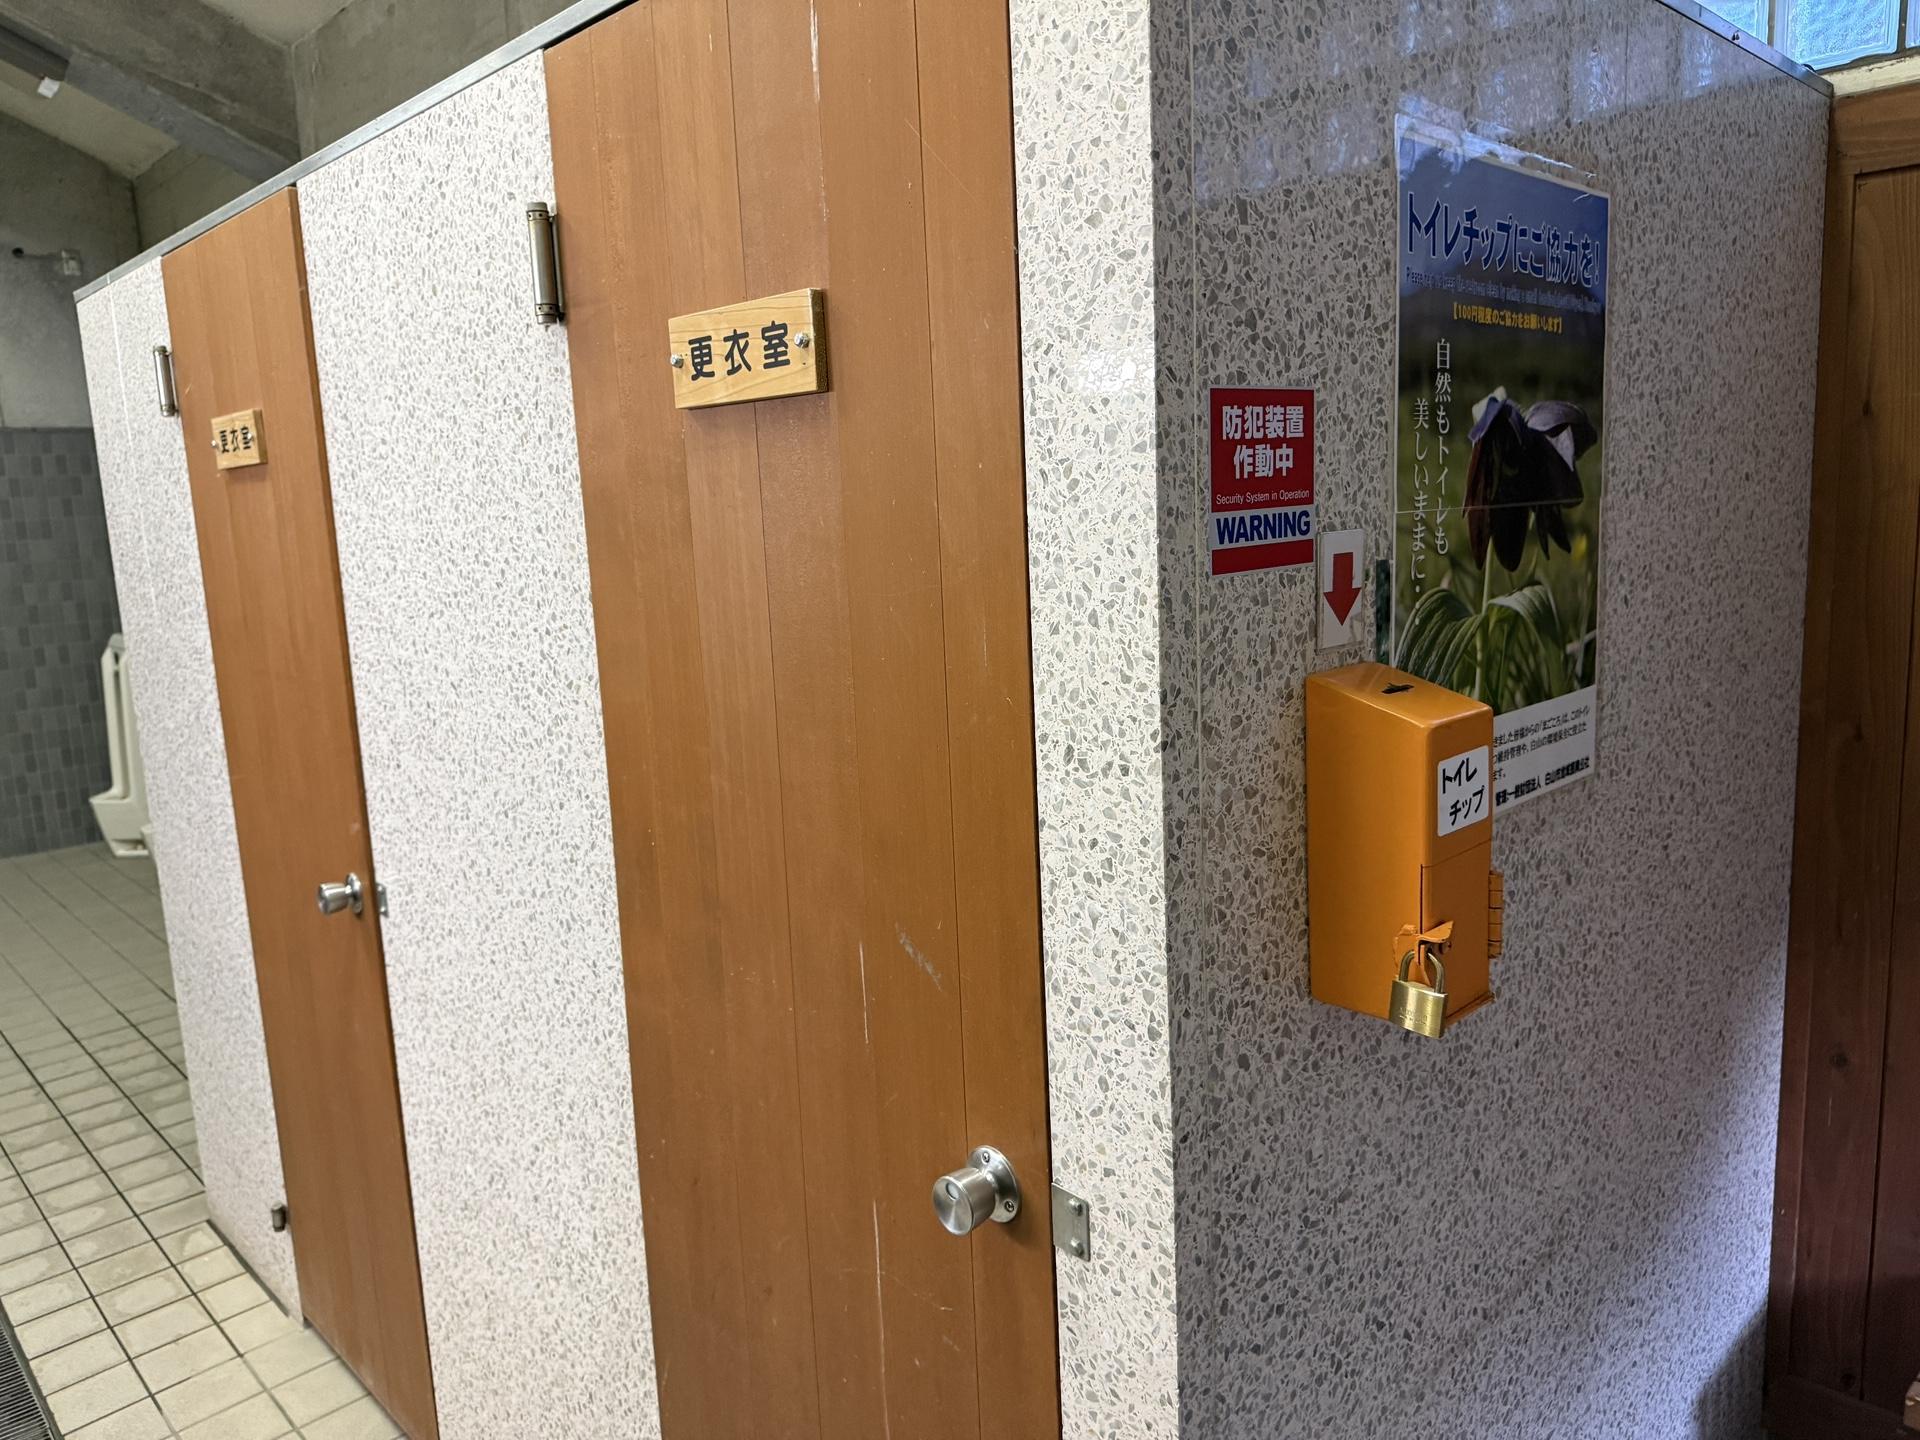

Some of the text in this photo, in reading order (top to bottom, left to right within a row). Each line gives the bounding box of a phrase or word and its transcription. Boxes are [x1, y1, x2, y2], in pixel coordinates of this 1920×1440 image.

[687, 319, 791, 382] 更衣室
[218, 425, 252, 455] 更衣室
[1221, 404, 1305, 441] 防犯装置
[1233, 443, 1294, 480] 作動中
[1434, 337, 1451, 556] 自然もトイレも
[1216, 488, 1310, 506] Security System in Operation
[1216, 509, 1311, 546] WARNING
[1442, 757, 1478, 795] トイレ
[1449, 784, 1485, 827] チップ
